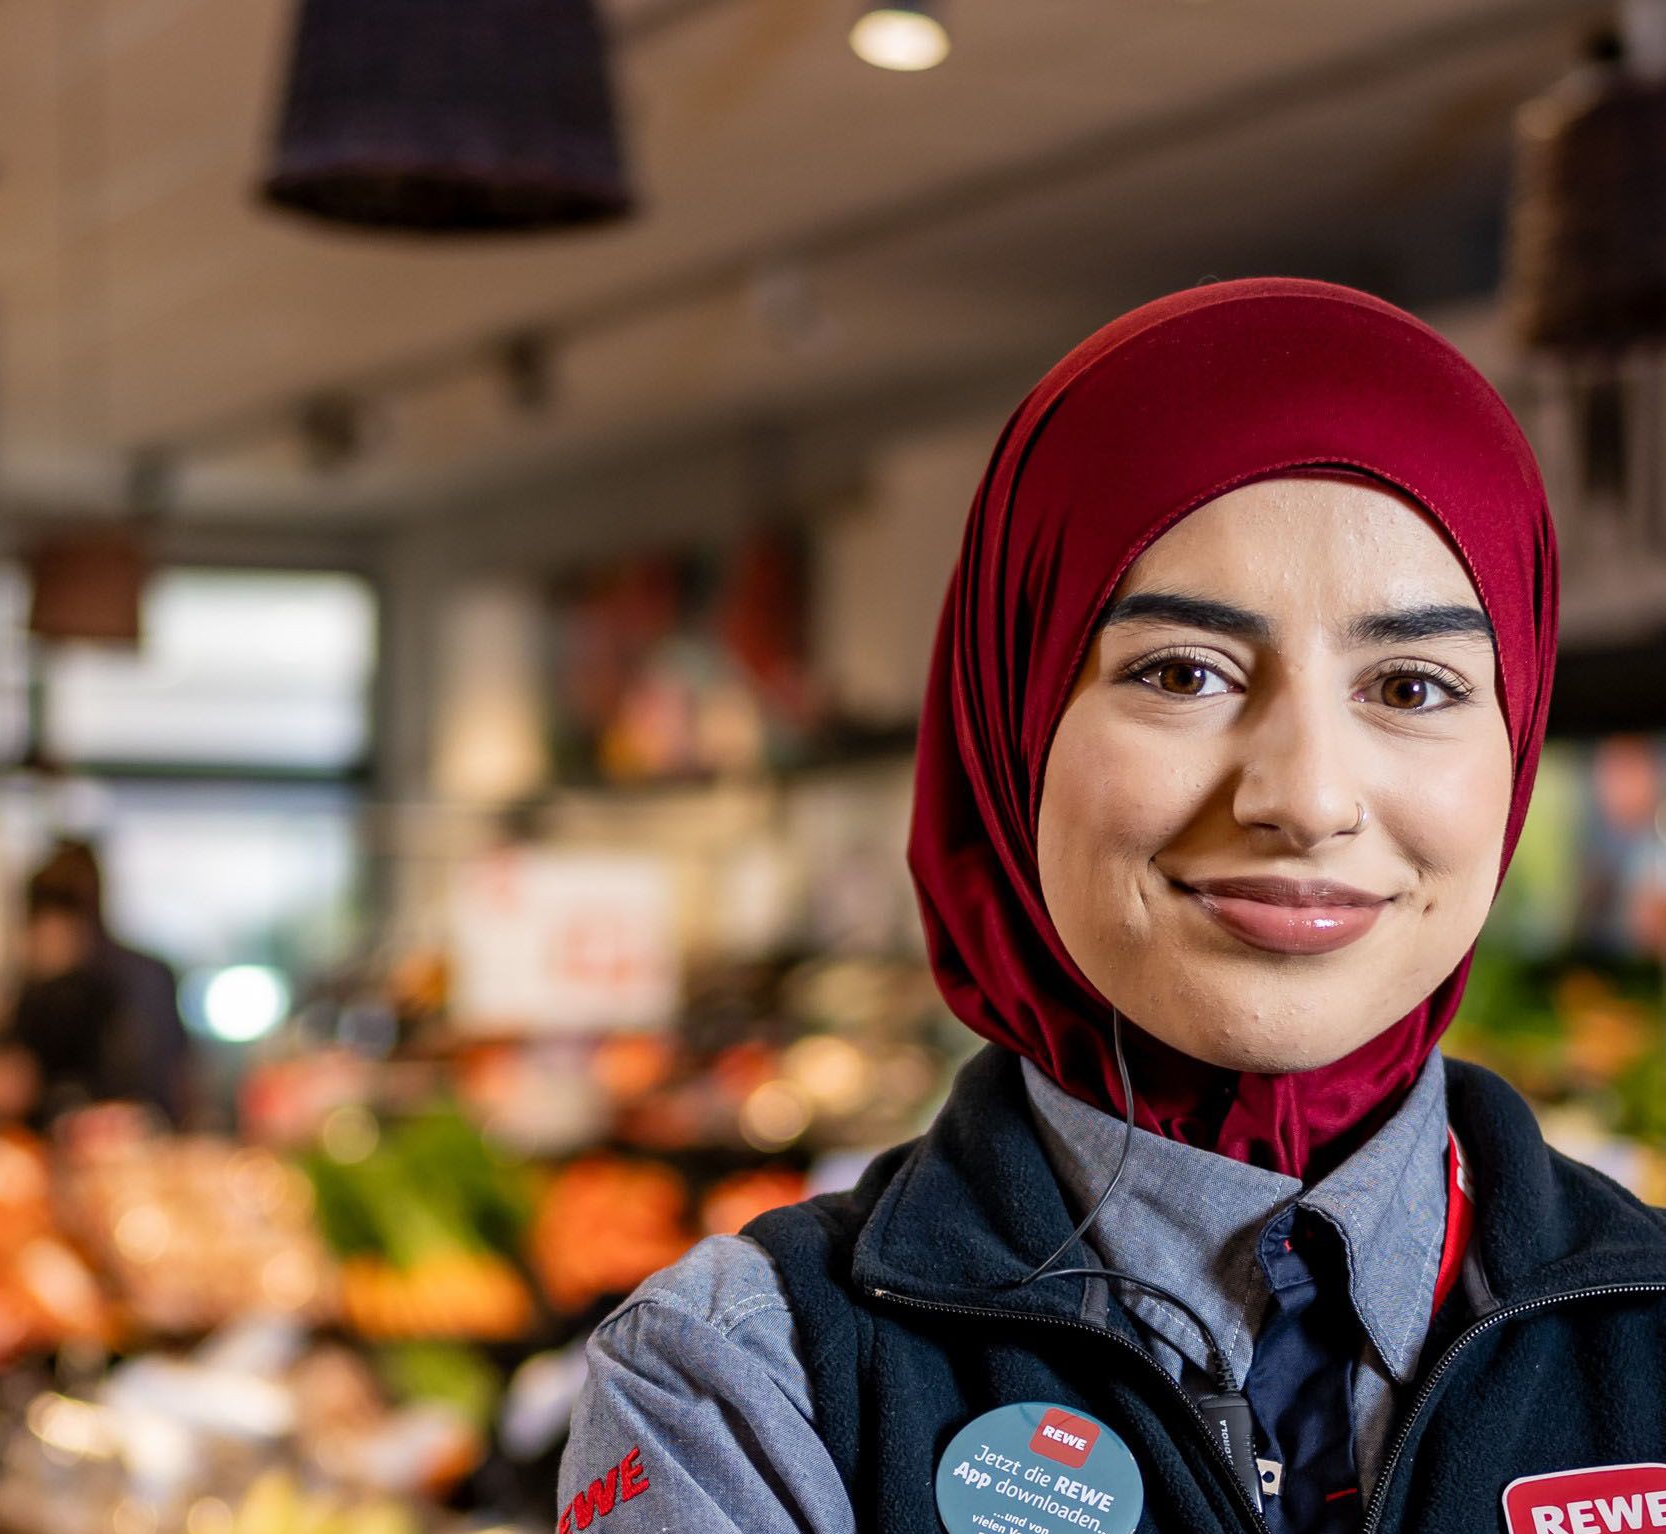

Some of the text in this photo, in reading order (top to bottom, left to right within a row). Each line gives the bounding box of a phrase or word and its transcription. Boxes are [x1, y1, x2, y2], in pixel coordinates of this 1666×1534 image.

[1042, 1425, 1087, 1451] REWE
[953, 1461, 992, 1490] App
[974, 1444, 1115, 1513] Jetzt die REWE
[971, 1513, 1007, 1534] vielen
[993, 1511, 1028, 1528] ...und
